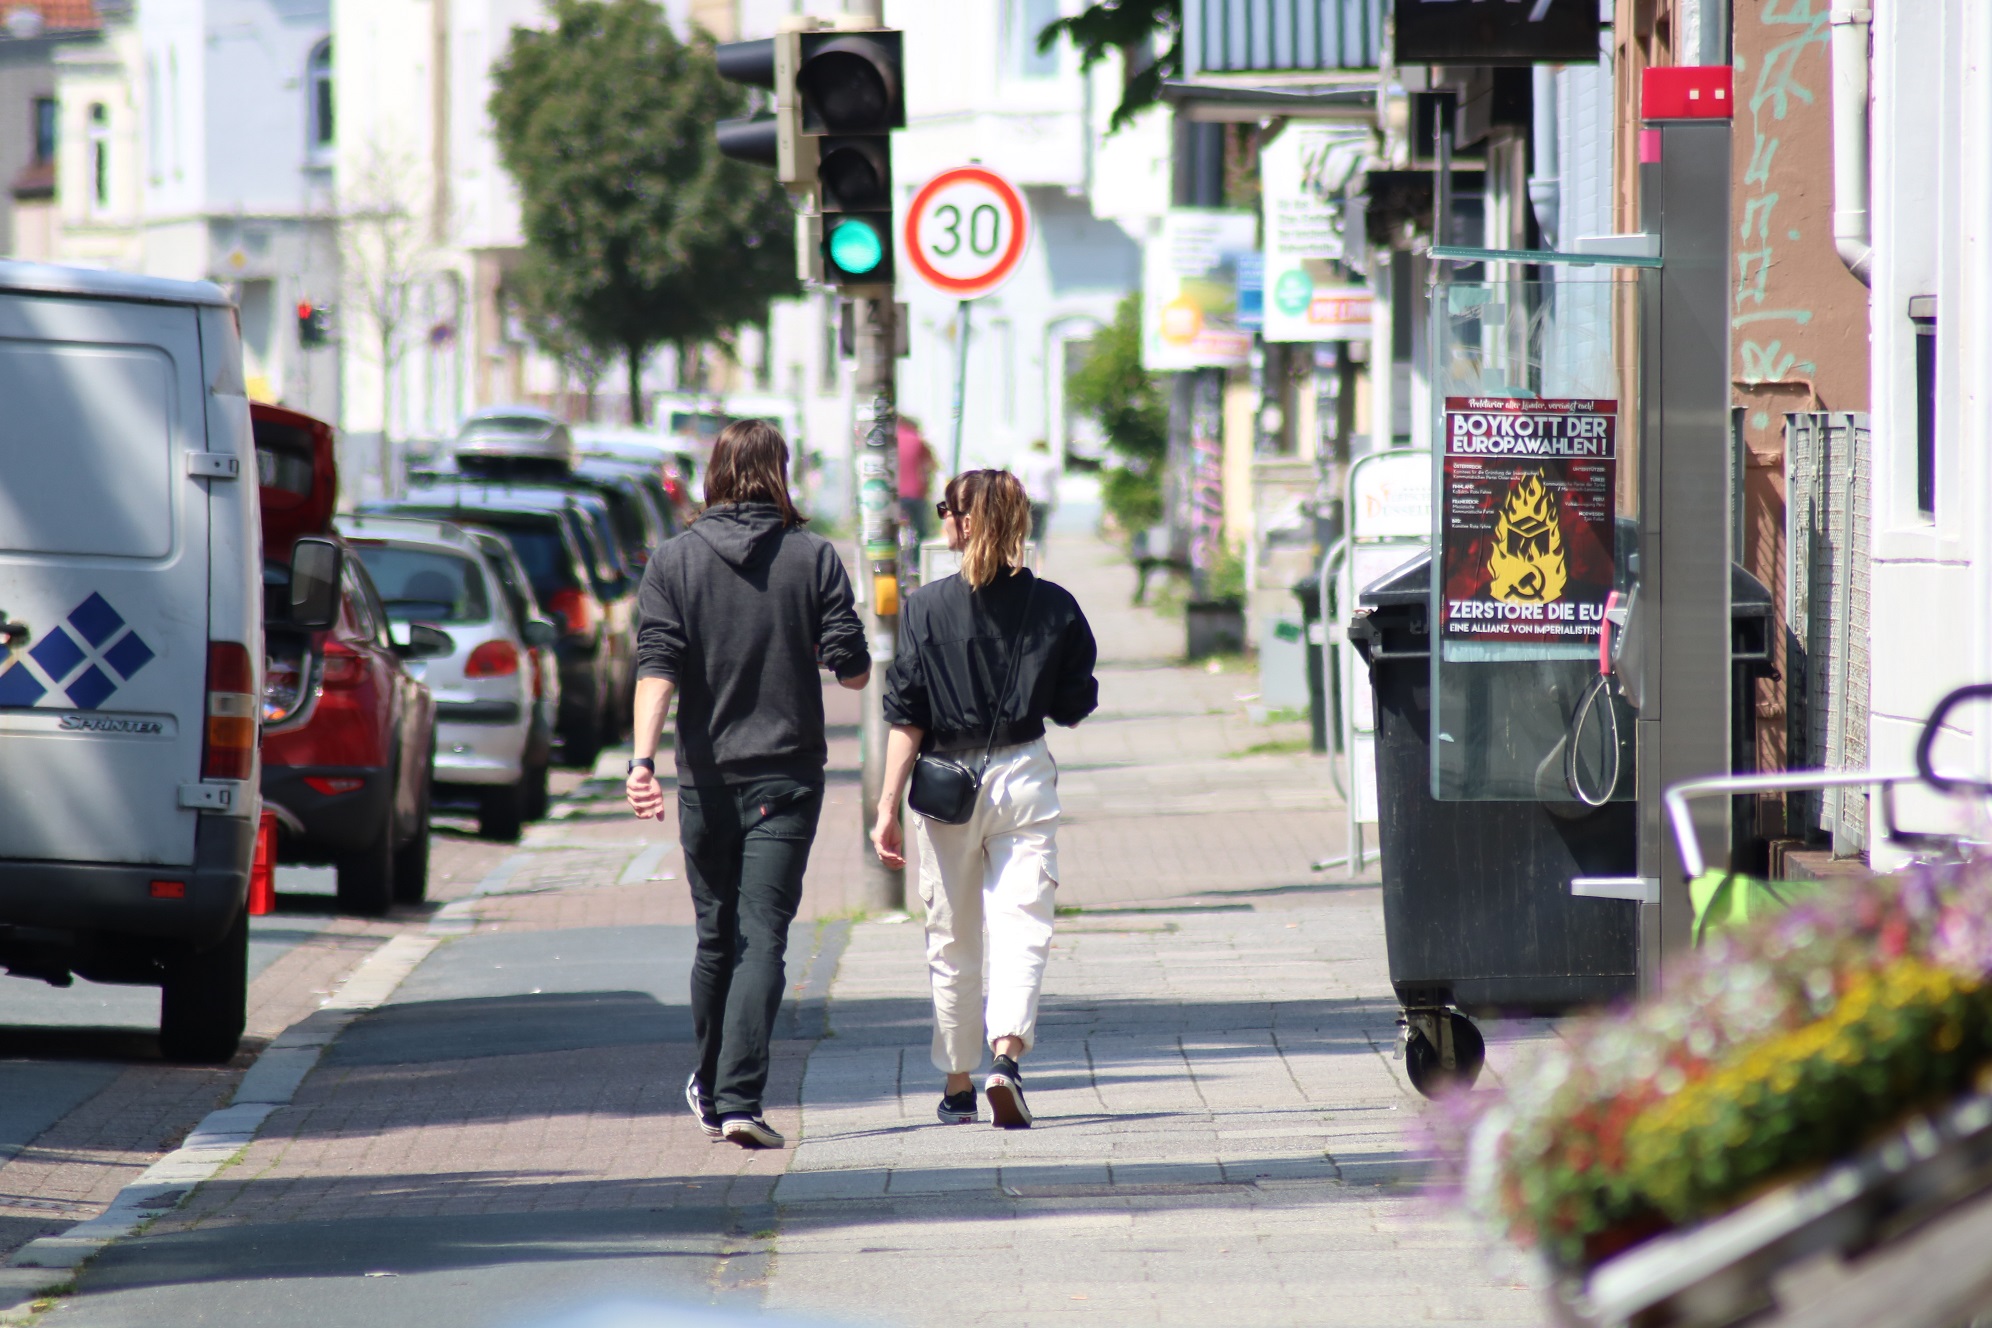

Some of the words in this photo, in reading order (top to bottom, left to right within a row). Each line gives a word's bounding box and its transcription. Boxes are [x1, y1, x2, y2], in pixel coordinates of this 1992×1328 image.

[932, 204, 1000, 258] 30
[1505, 401, 1520, 410] aller
[1453, 415, 1563, 437] BOYKOTT
[1567, 417, 1608, 438] DER
[1452, 436, 1597, 455] EUROPAWAHLEN
[1449, 600, 1544, 620] ZERSTÖRE
[1548, 603, 1575, 621] DIE
[1579, 604, 1603, 621] EU
[1449, 624, 1469, 633] EINE
[1471, 624, 1510, 634] ALLIANZ
[1511, 625, 1533, 634] VON
[1534, 625, 1603, 636] IMPERIALISTEN!
